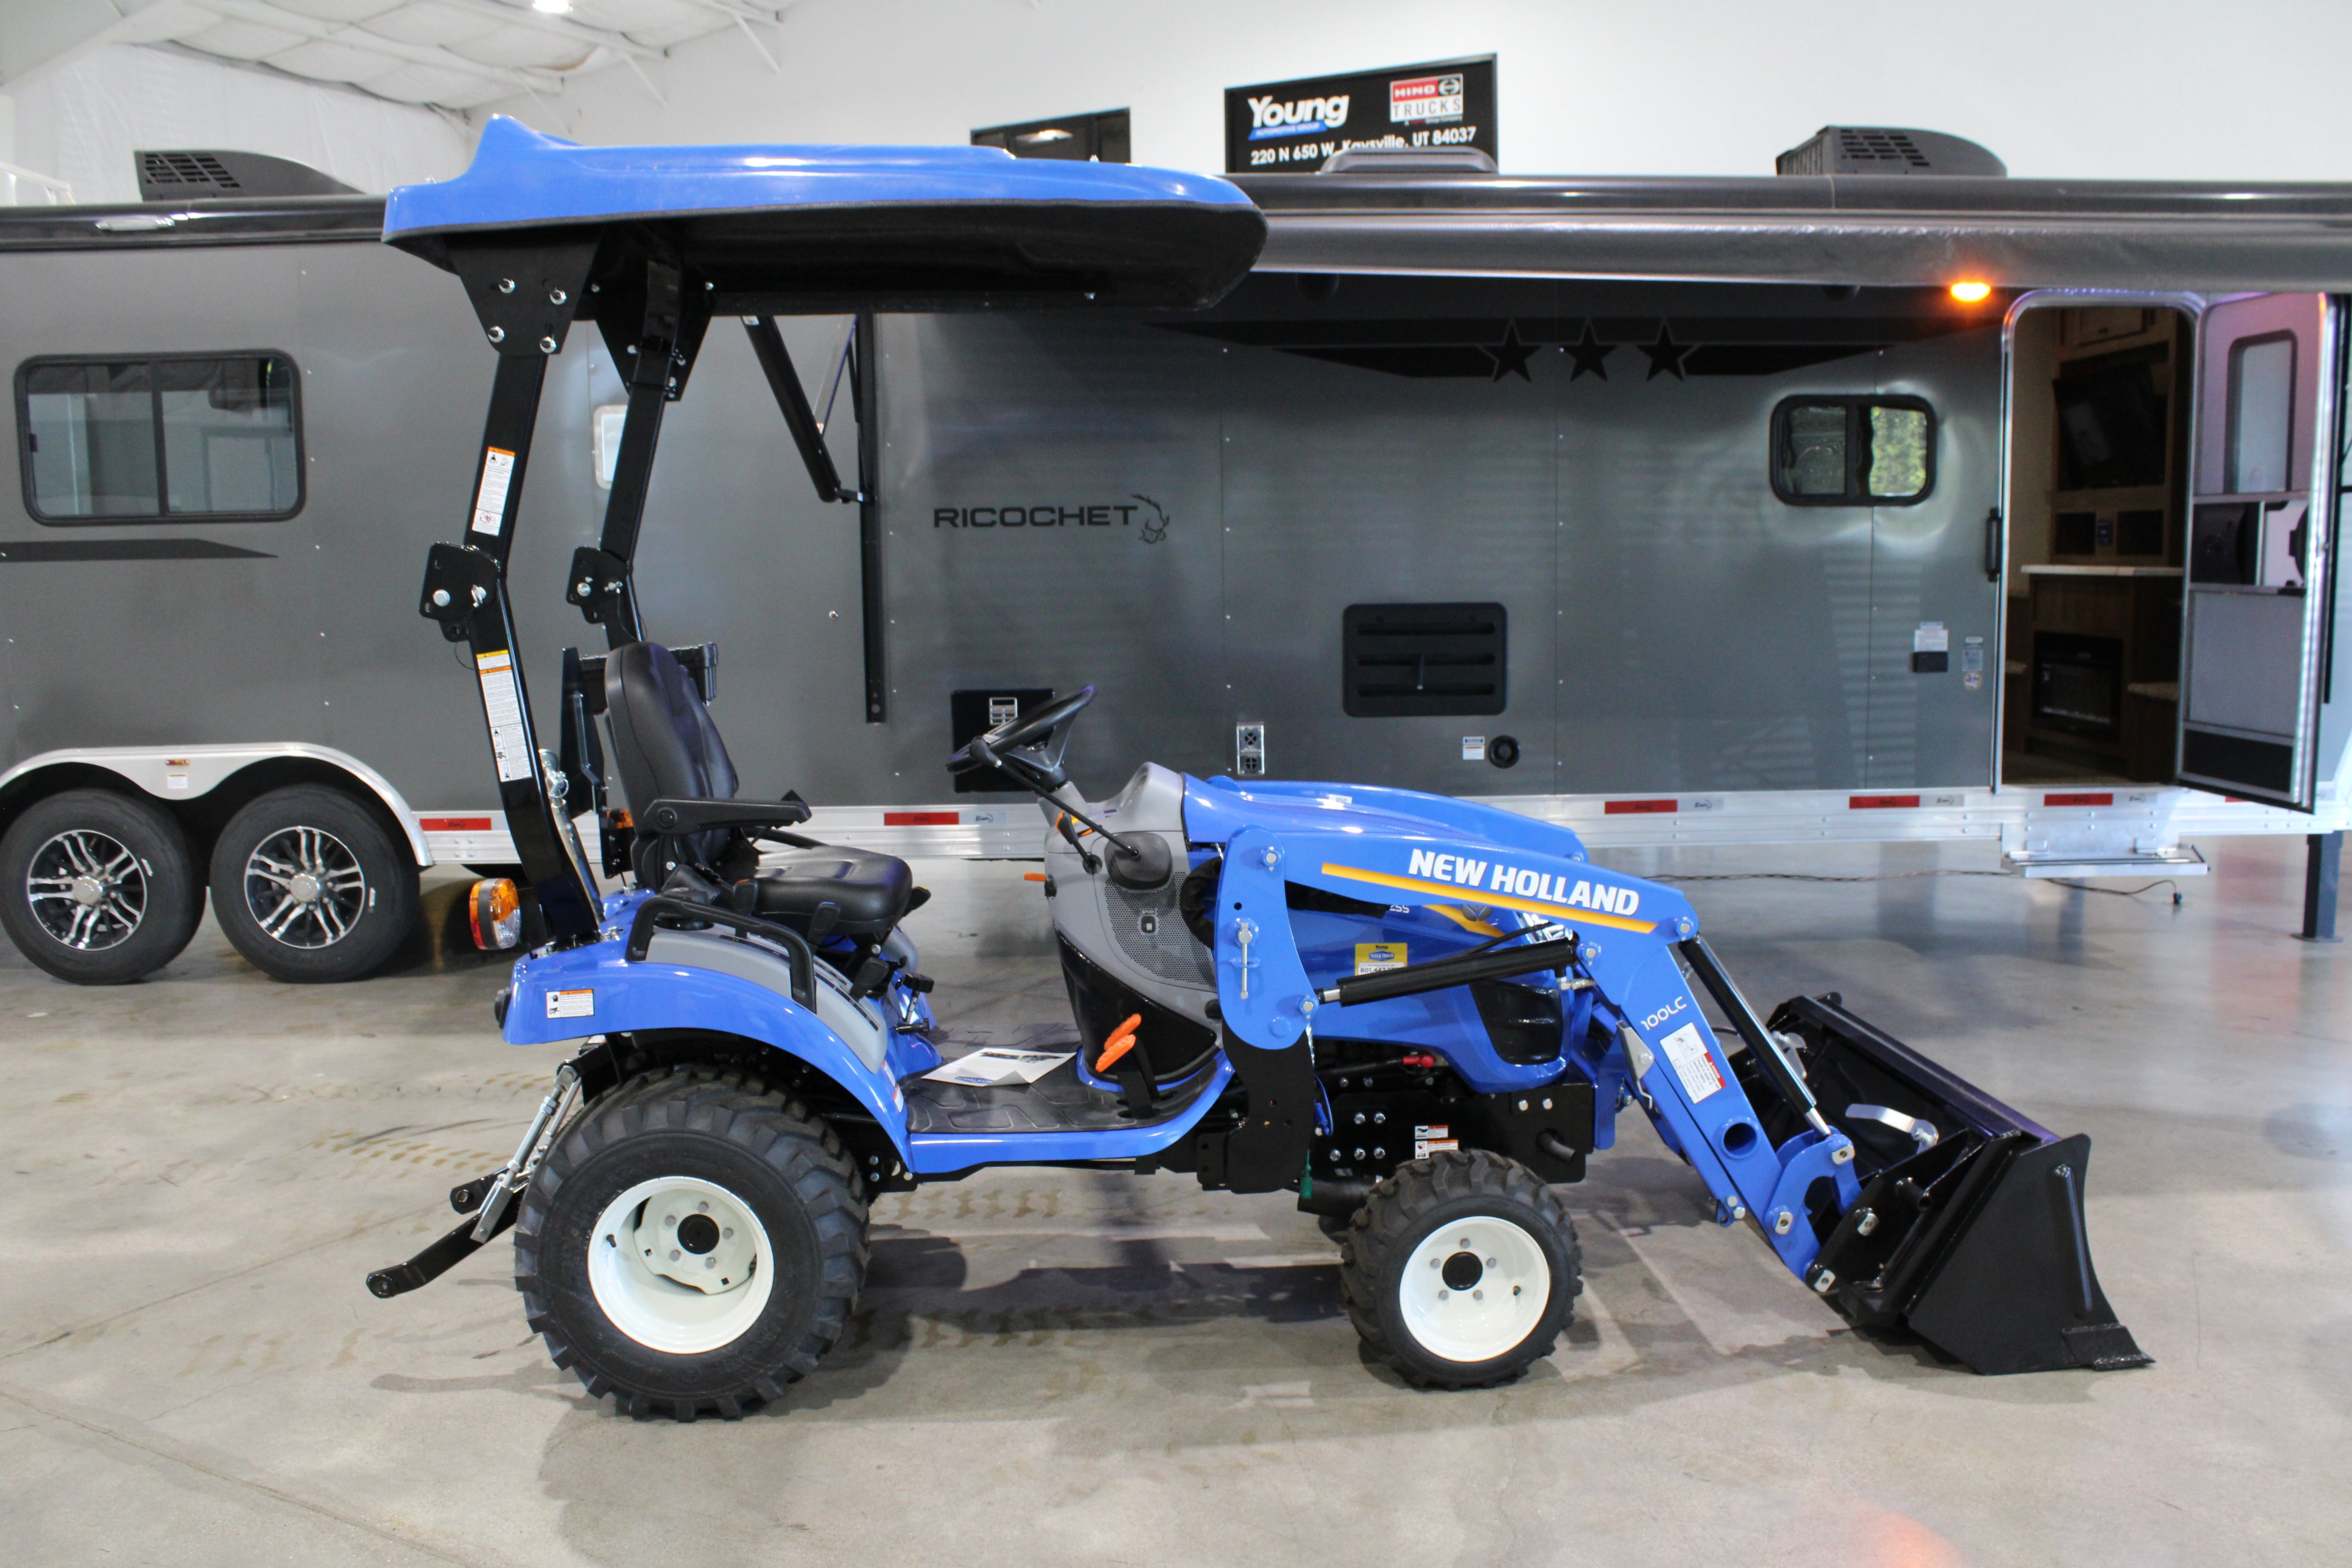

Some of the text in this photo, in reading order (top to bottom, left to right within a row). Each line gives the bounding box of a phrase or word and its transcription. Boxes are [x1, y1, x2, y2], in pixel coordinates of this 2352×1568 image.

[1394, 85, 1436, 98] HINO
[1247, 95, 1350, 128] Young
[1393, 98, 1461, 119] TRUCKS
[1251, 150, 1276, 166] 220
[1278, 147, 1290, 162] N
[1293, 143, 1318, 161] 650
[1412, 131, 1430, 147] UT
[1432, 126, 1477, 145] 84037
[933, 506, 1138, 528] RICOCHET
[1408, 848, 1639, 916] NEW HOLLAND
[1641, 996, 1687, 1031] 100LC
